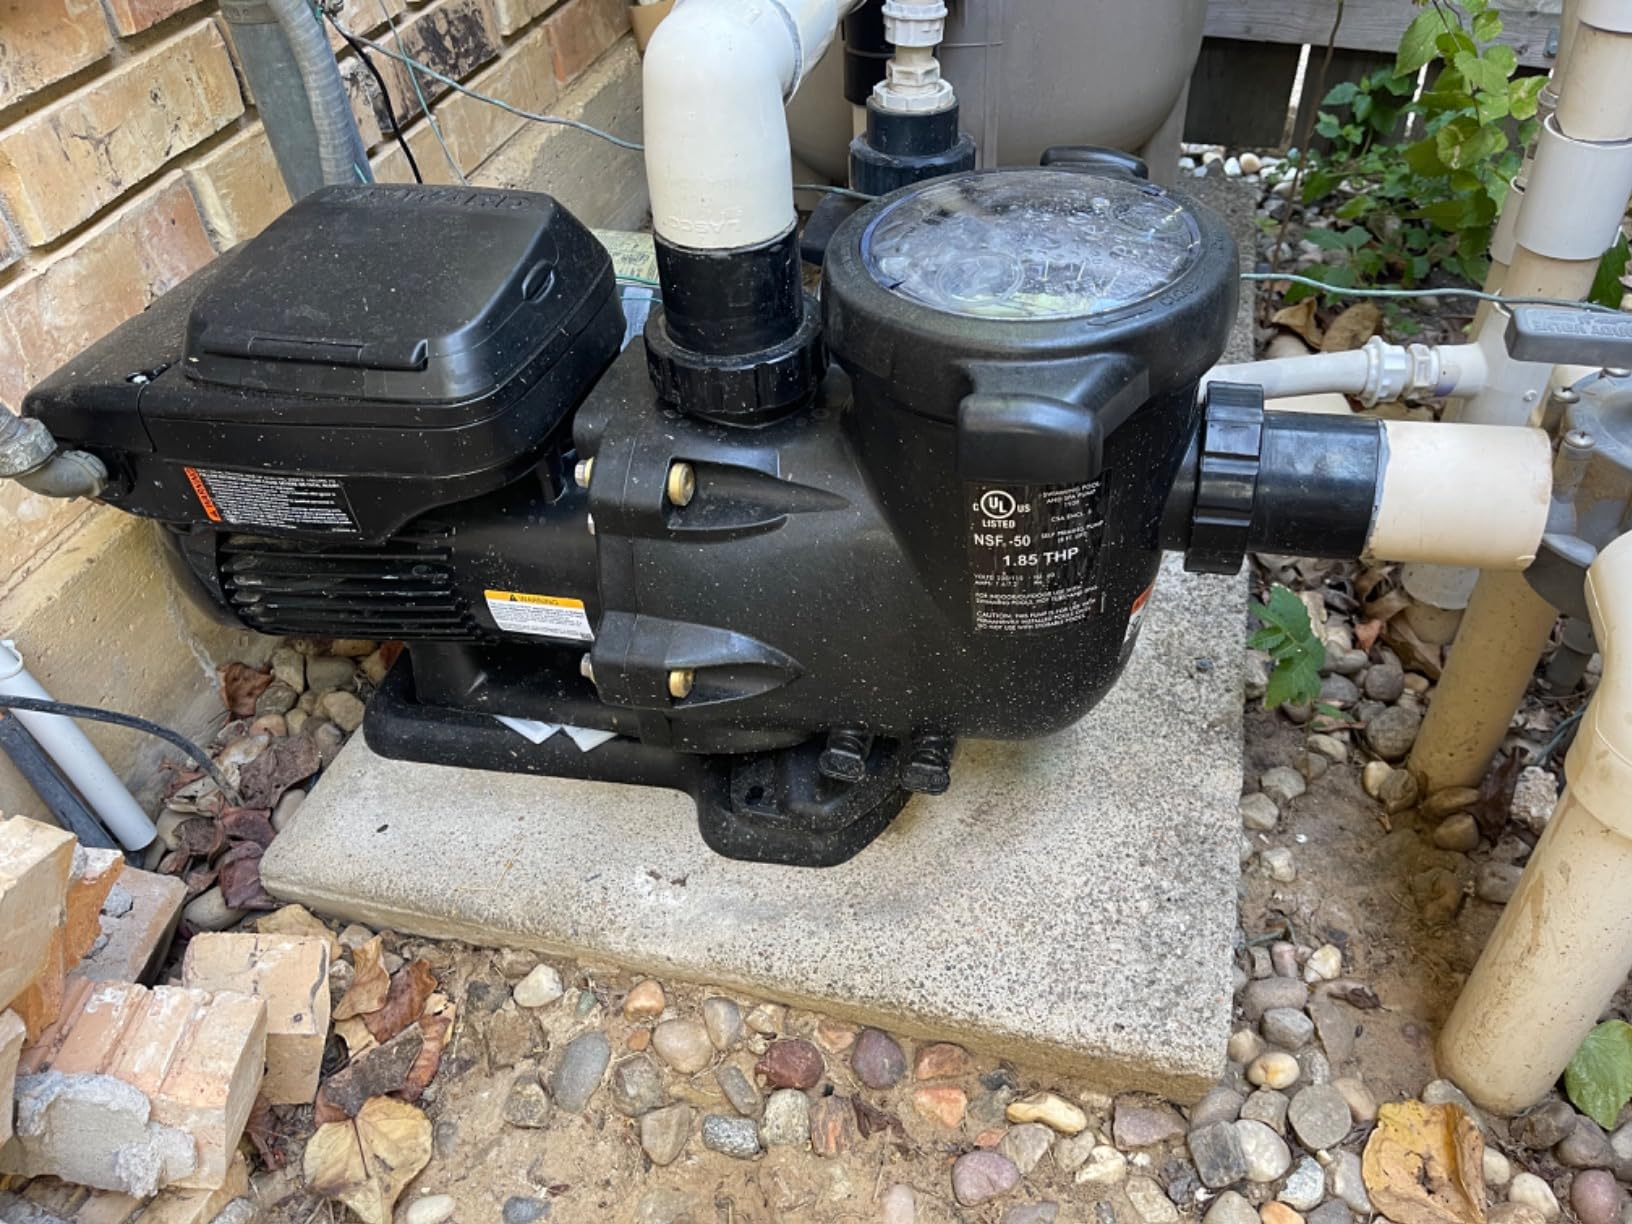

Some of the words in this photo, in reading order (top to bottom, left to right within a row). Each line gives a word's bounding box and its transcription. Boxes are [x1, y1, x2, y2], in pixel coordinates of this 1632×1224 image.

[1017, 503, 1031, 513] US
[982, 519, 1016, 529] LISTED
[1002, 554, 1038, 566] 1.85
[1043, 547, 1079, 565] THP
